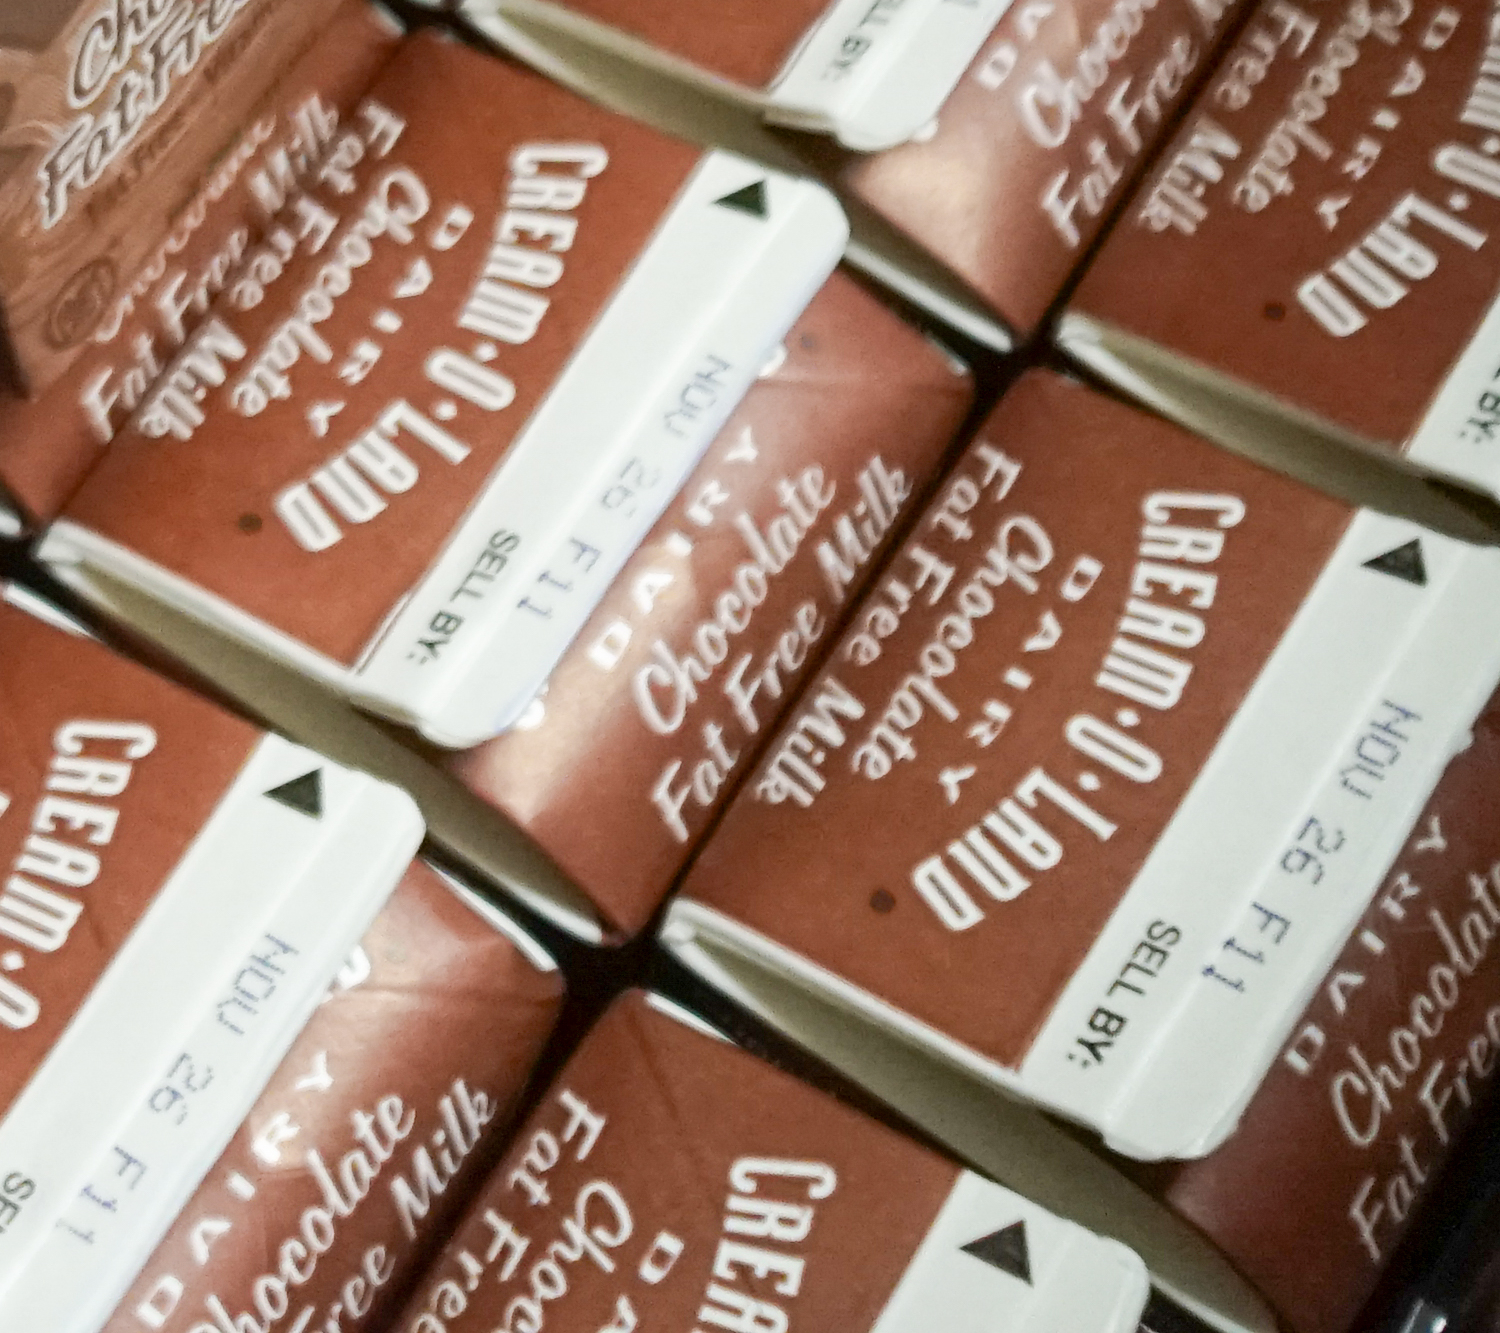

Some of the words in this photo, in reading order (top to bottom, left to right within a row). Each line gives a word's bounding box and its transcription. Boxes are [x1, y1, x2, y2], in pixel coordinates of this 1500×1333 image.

[40, 68, 149, 230] Fat
[327, 98, 408, 195] Fat
[1138, 119, 1241, 237] Milk
[229, 203, 340, 313] Free
[229, 163, 430, 418] Chocolate
[929, 442, 1025, 542] Fat
[448, 526, 520, 611] SELL
[633, 461, 838, 736] Chocolate
[849, 540, 958, 668] Free
[405, 606, 465, 668] BY:
[651, 746, 731, 843] Fat
[725, 615, 820, 750] Free
[828, 452, 916, 602] Milk
[851, 512, 1054, 780] Chocolate
[757, 678, 865, 809] Milk
[1279, 813, 1347, 884] 26
[1104, 915, 1183, 1010] SELL
[1067, 1004, 1130, 1069] BY:
[391, 1076, 500, 1235] Milk
[507, 1086, 608, 1207] Fat
[192, 1091, 416, 1333] hocolate
[1349, 1166, 1427, 1262] Fat
